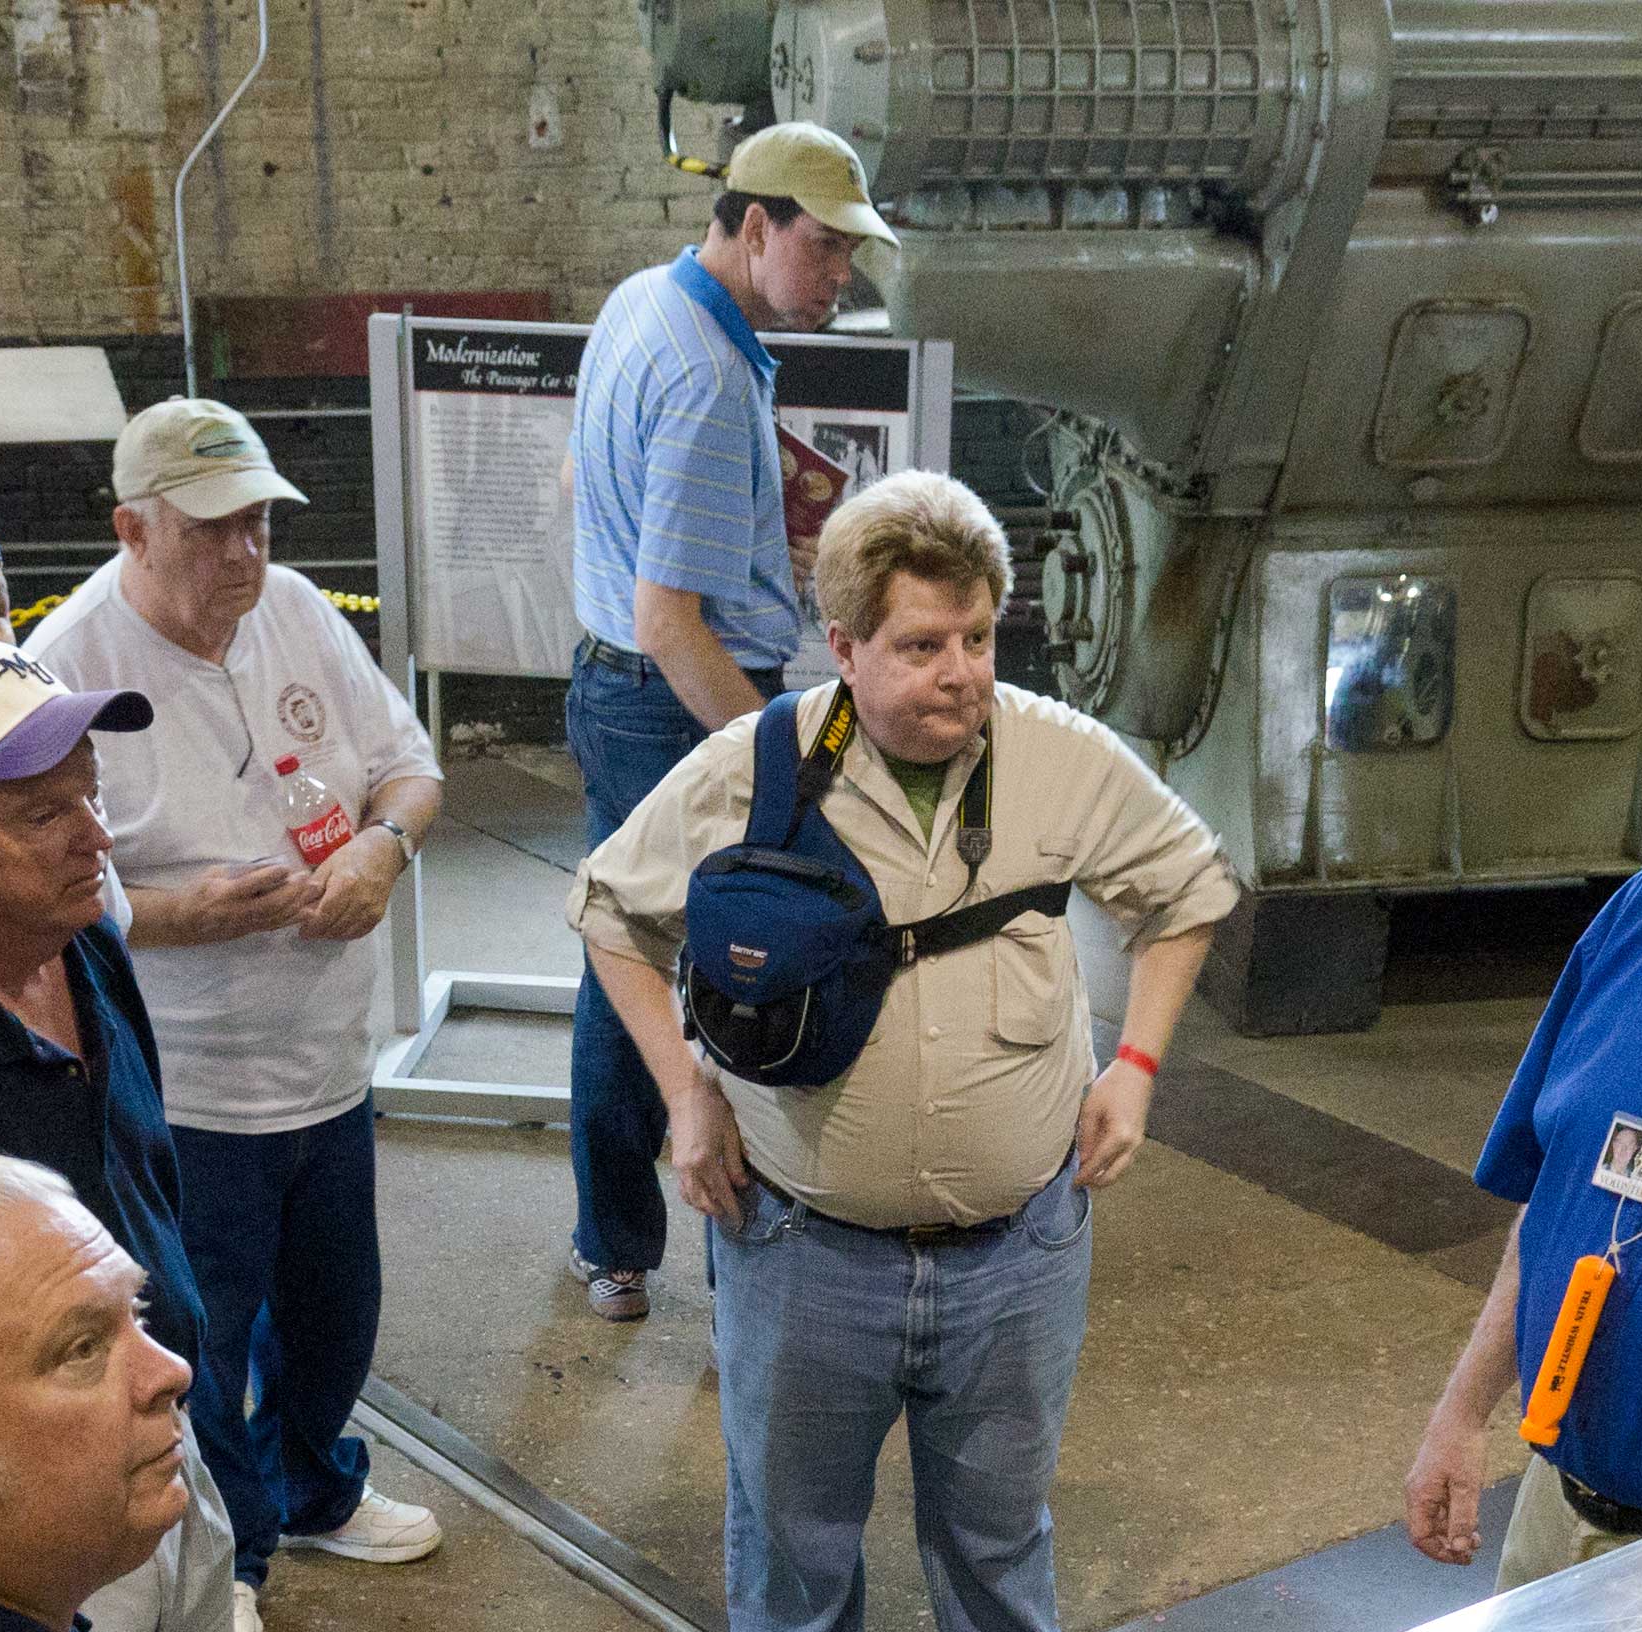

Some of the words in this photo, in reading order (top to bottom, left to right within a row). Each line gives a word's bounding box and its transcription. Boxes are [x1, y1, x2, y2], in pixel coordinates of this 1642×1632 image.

[426, 336, 541, 367] Modernization:
[461, 365, 482, 385] The
[487, 370, 539, 394] Passenger
[541, 373, 561, 388] Car
[1574, 1290, 1592, 1322] TRAIN
[1557, 1325, 1579, 1373] WHISTLE
